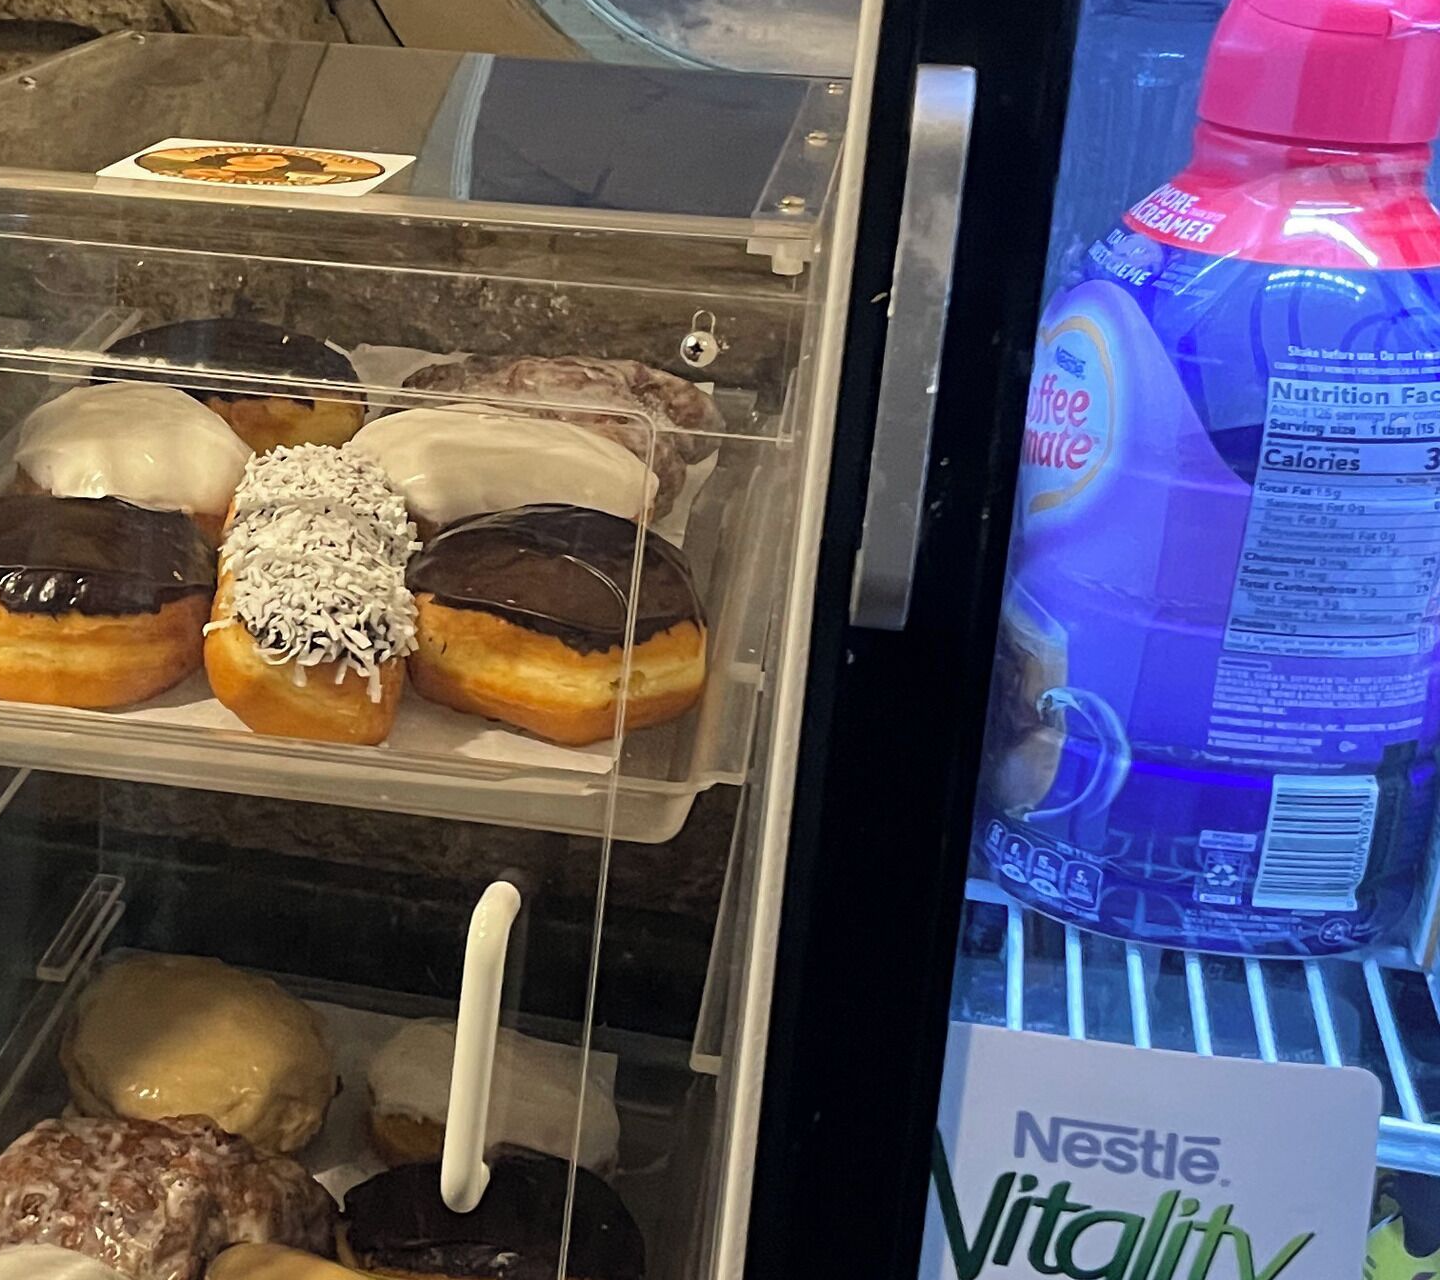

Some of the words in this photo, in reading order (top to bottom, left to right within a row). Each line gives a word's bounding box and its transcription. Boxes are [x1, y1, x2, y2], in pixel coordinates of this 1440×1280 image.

[1272, 381, 1389, 405] Nutrition
[1269, 418, 1326, 436] Serving
[1264, 448, 1360, 471] Calories
